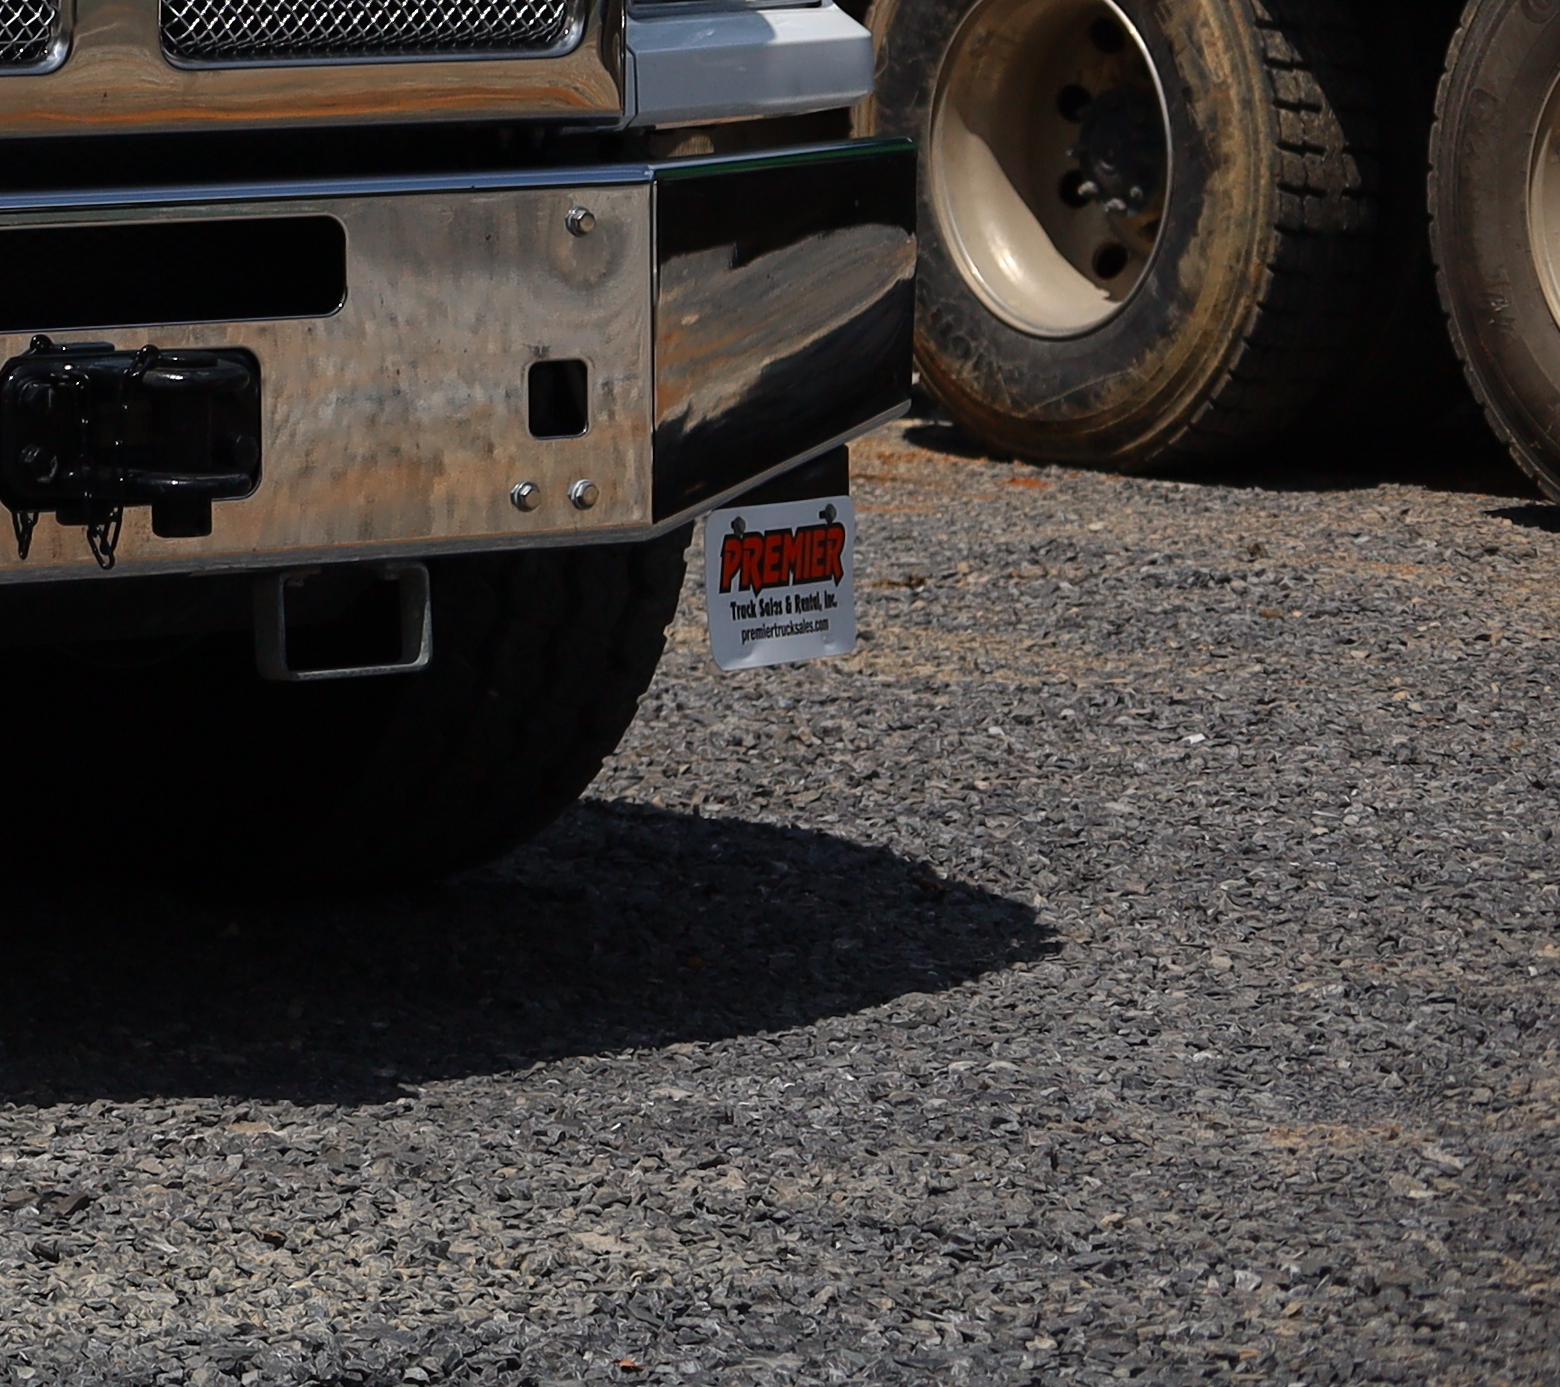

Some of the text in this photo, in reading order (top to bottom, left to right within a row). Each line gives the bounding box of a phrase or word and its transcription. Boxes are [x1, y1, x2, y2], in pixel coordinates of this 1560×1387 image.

[719, 522, 846, 598] PREMIER
[730, 599, 757, 621] Truck
[760, 596, 783, 618] Sales
[786, 593, 792, 615] &
[824, 589, 838, 609] Inc.
[741, 617, 830, 645] premiertrucksales.com
